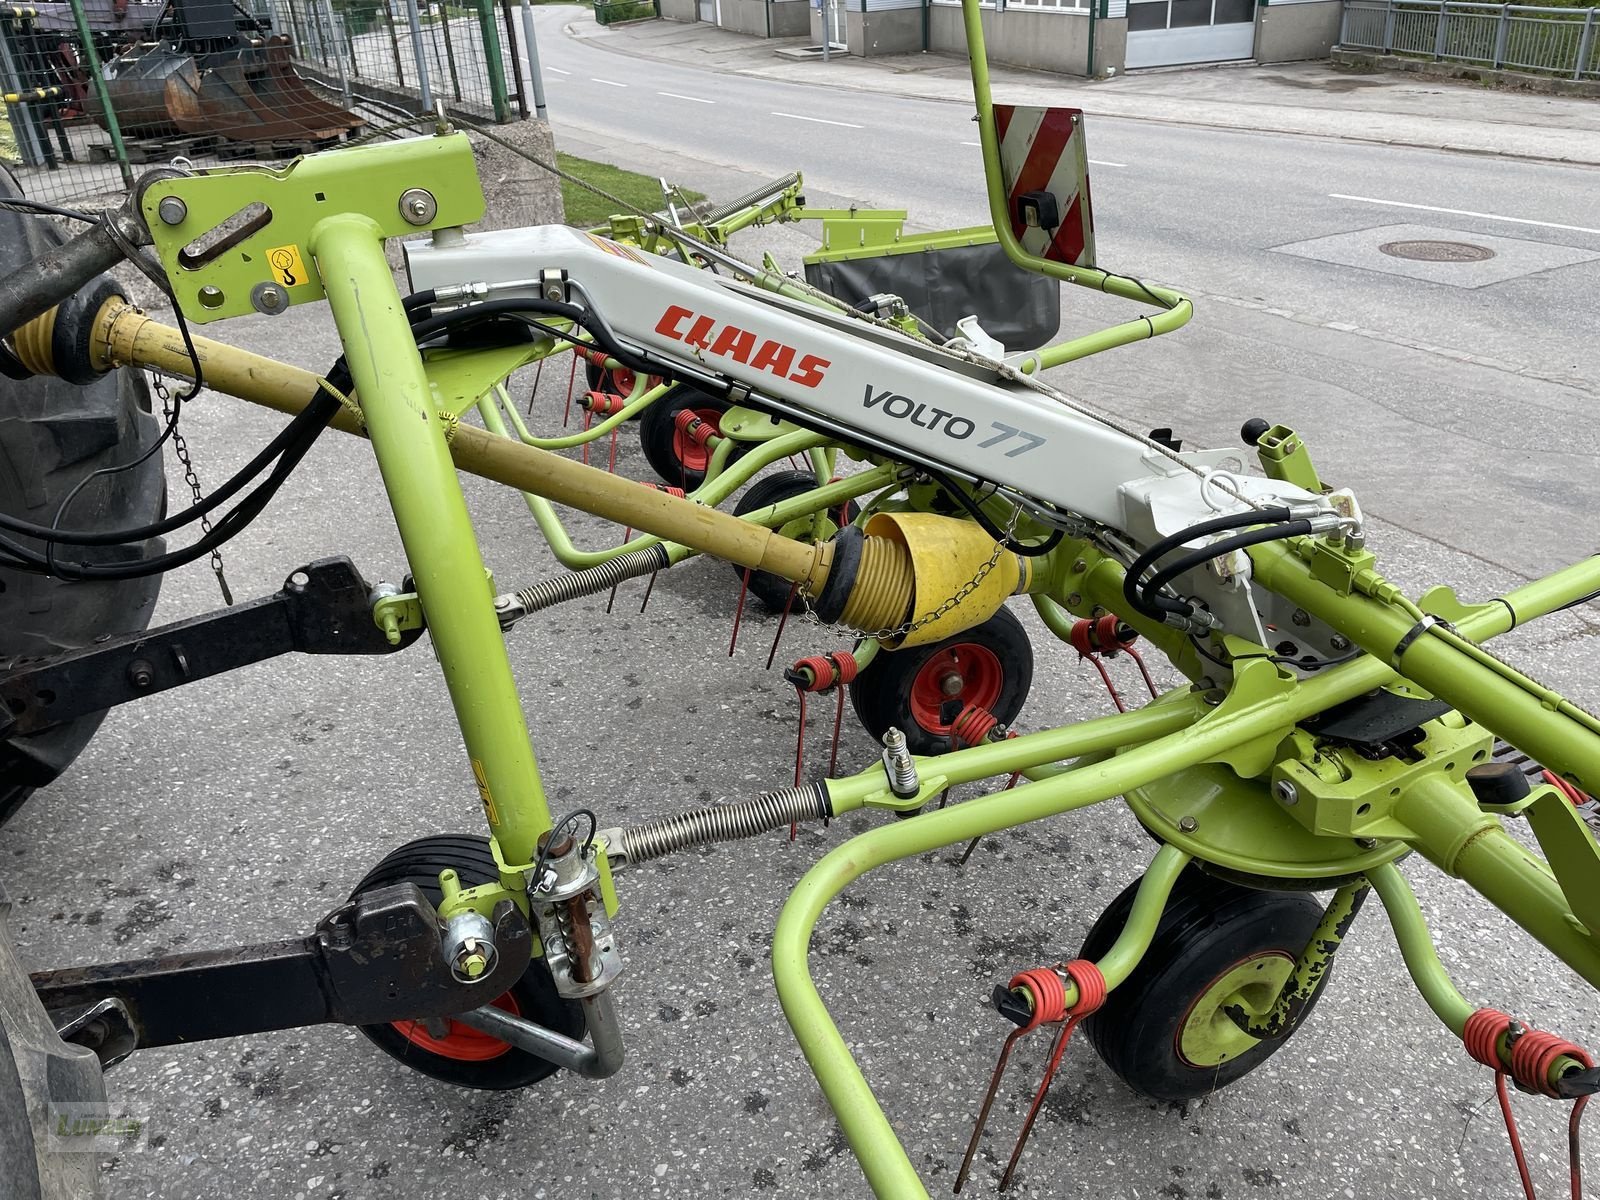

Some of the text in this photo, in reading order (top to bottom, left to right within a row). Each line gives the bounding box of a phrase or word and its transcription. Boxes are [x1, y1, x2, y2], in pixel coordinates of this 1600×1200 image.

[655, 305, 832, 388] CLAAS
[863, 384, 1048, 458] VOLTO 77
